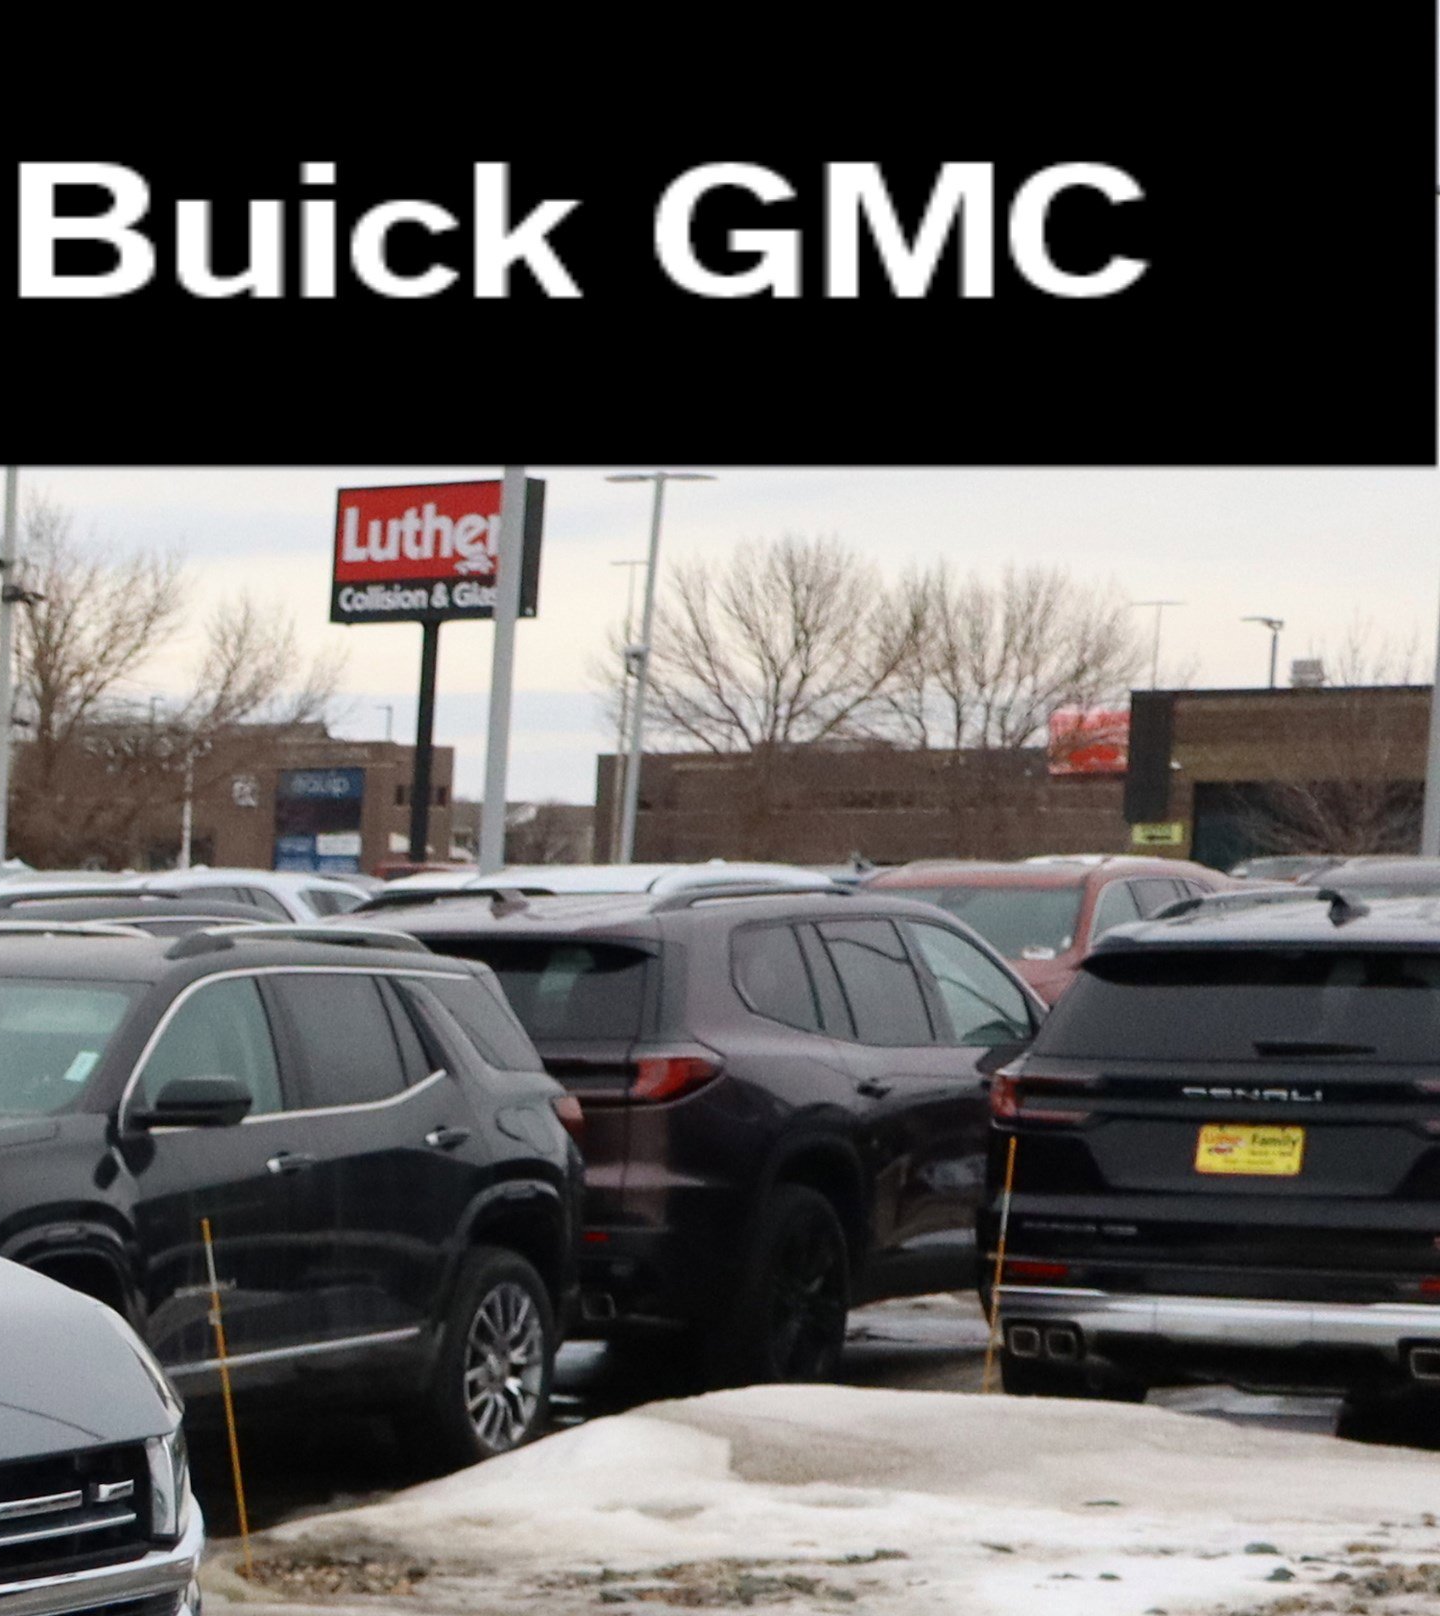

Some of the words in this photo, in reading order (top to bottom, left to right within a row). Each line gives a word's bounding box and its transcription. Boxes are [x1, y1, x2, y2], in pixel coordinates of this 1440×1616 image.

[341, 502, 503, 563] Luther
[338, 582, 429, 613] Collision
[430, 581, 449, 609] &
